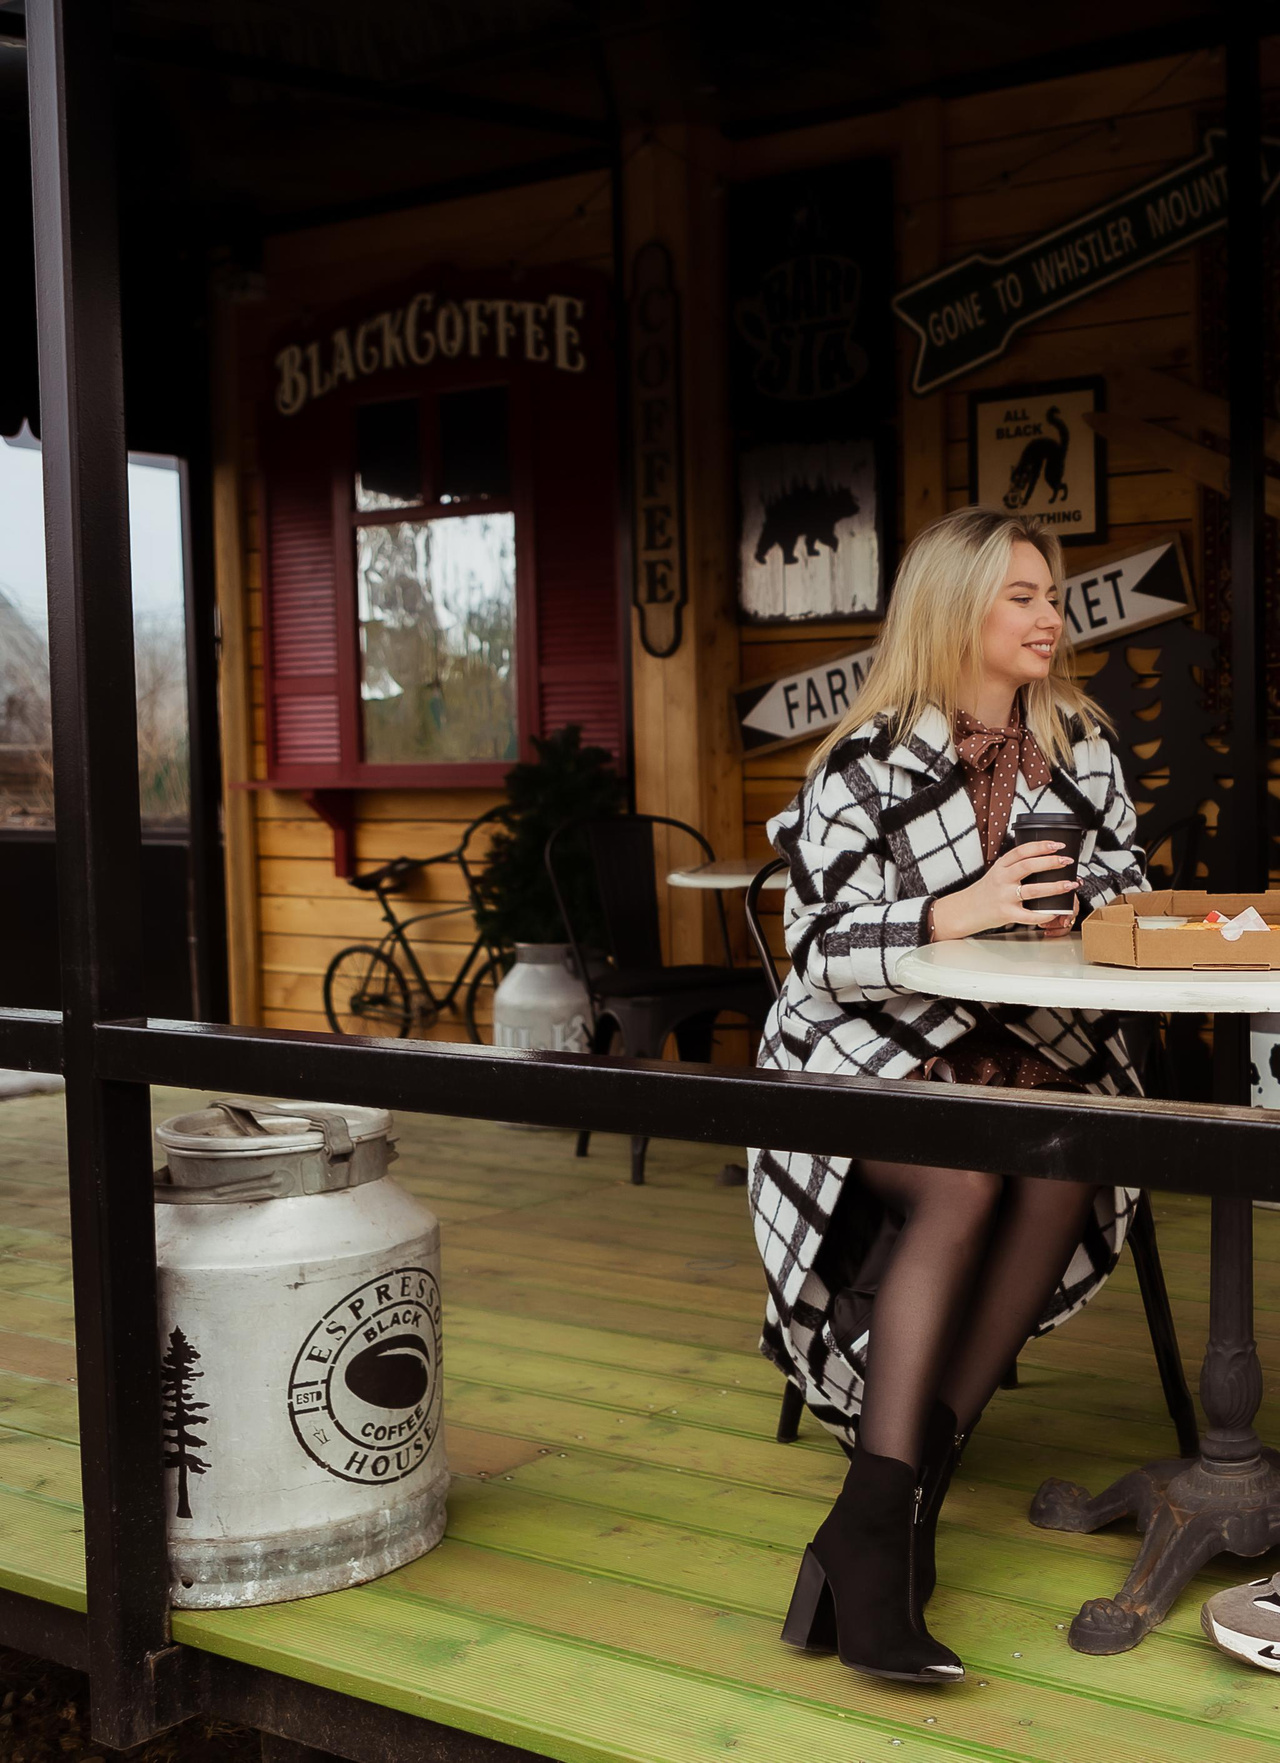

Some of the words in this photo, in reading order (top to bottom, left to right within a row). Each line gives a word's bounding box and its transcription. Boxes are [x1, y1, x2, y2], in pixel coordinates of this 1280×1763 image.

[927, 291, 987, 349] GONE
[992, 271, 1025, 315] TO
[1031, 215, 1138, 296] WHISTLER
[1145, 151, 1271, 240] MOUNT
[996, 423, 1042, 440] BLACK
[1004, 408, 1029, 423] ALL
[637, 287, 675, 604] COFFEE
[305, 1275, 442, 1365] ESPRESSO
[362, 1308, 422, 1344] BLACK
[361, 1403, 425, 1442] COFFEE
[344, 1420, 435, 1477] HOUSE
